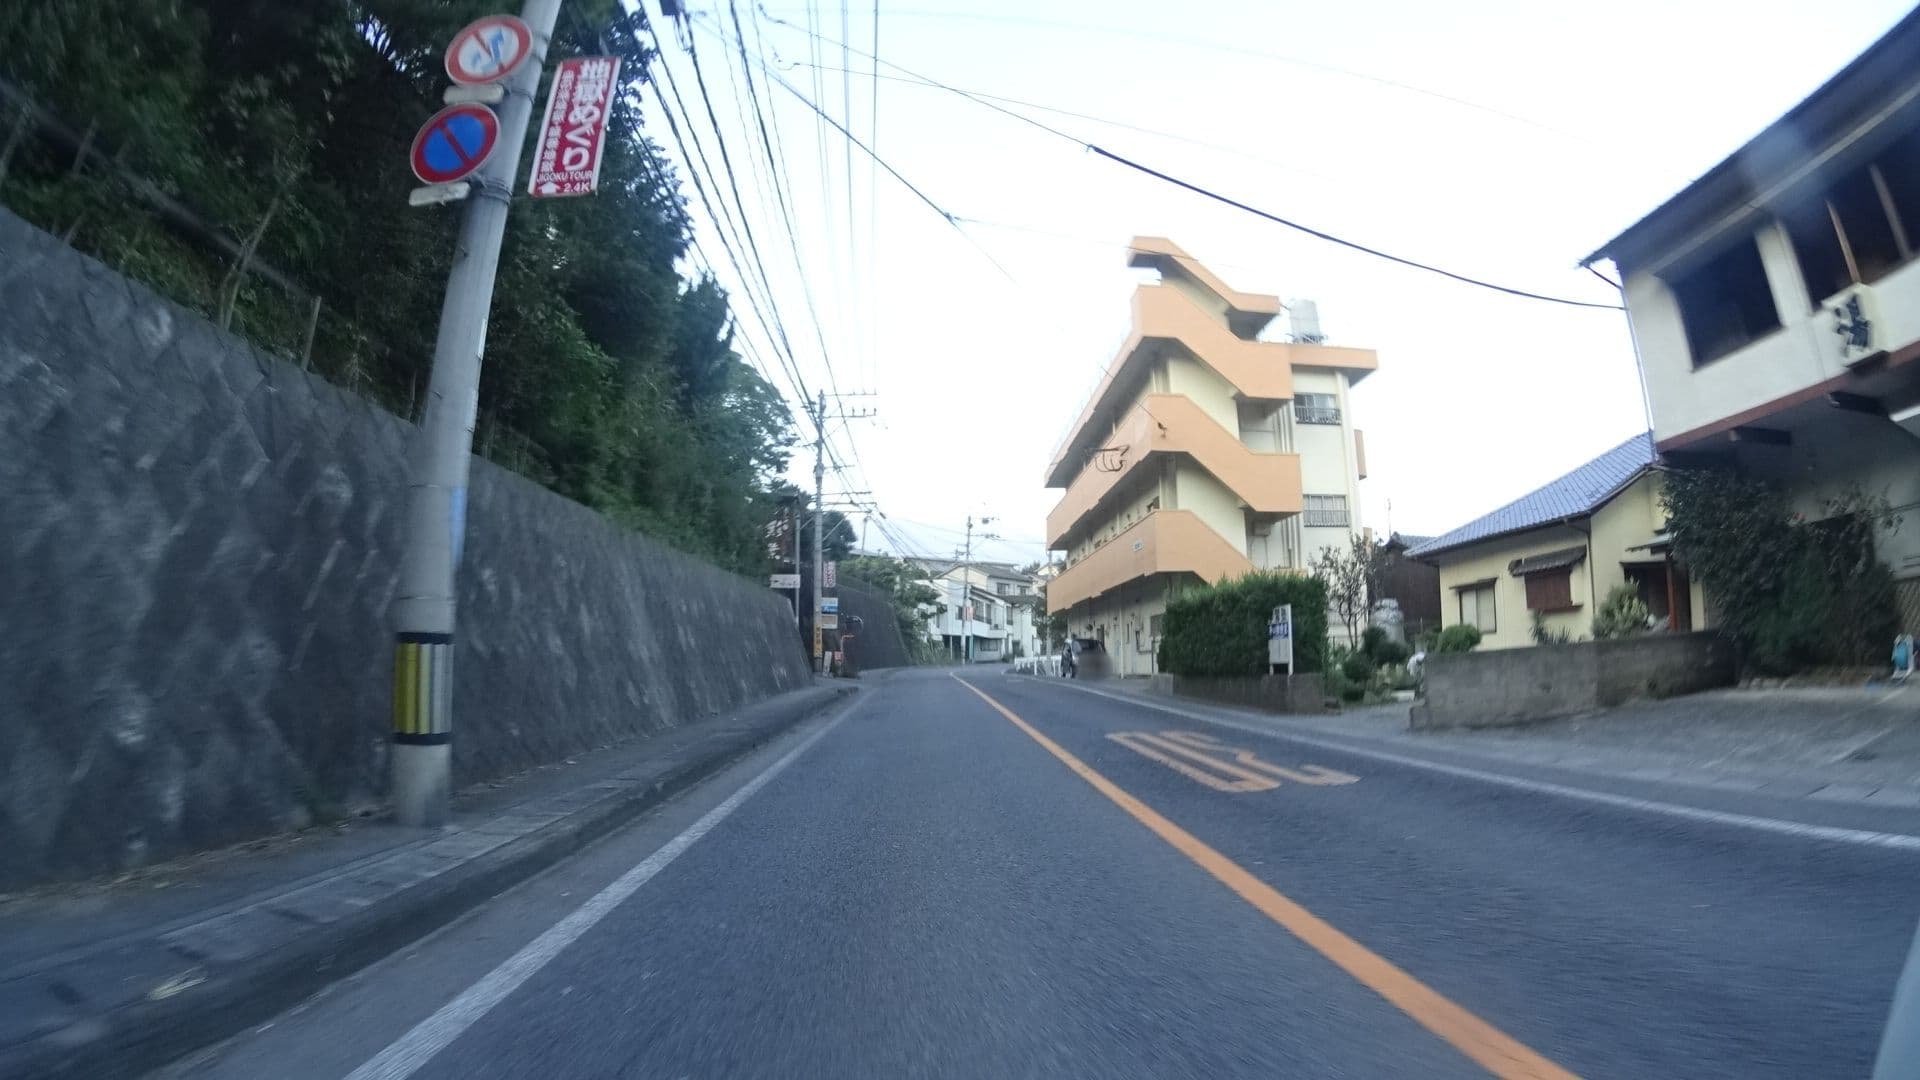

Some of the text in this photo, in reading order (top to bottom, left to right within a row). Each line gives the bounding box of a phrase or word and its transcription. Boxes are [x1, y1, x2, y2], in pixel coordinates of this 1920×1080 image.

[563, 59, 611, 171] 地獄めぐり
[536, 170, 593, 183] JIGOKU TOUR
